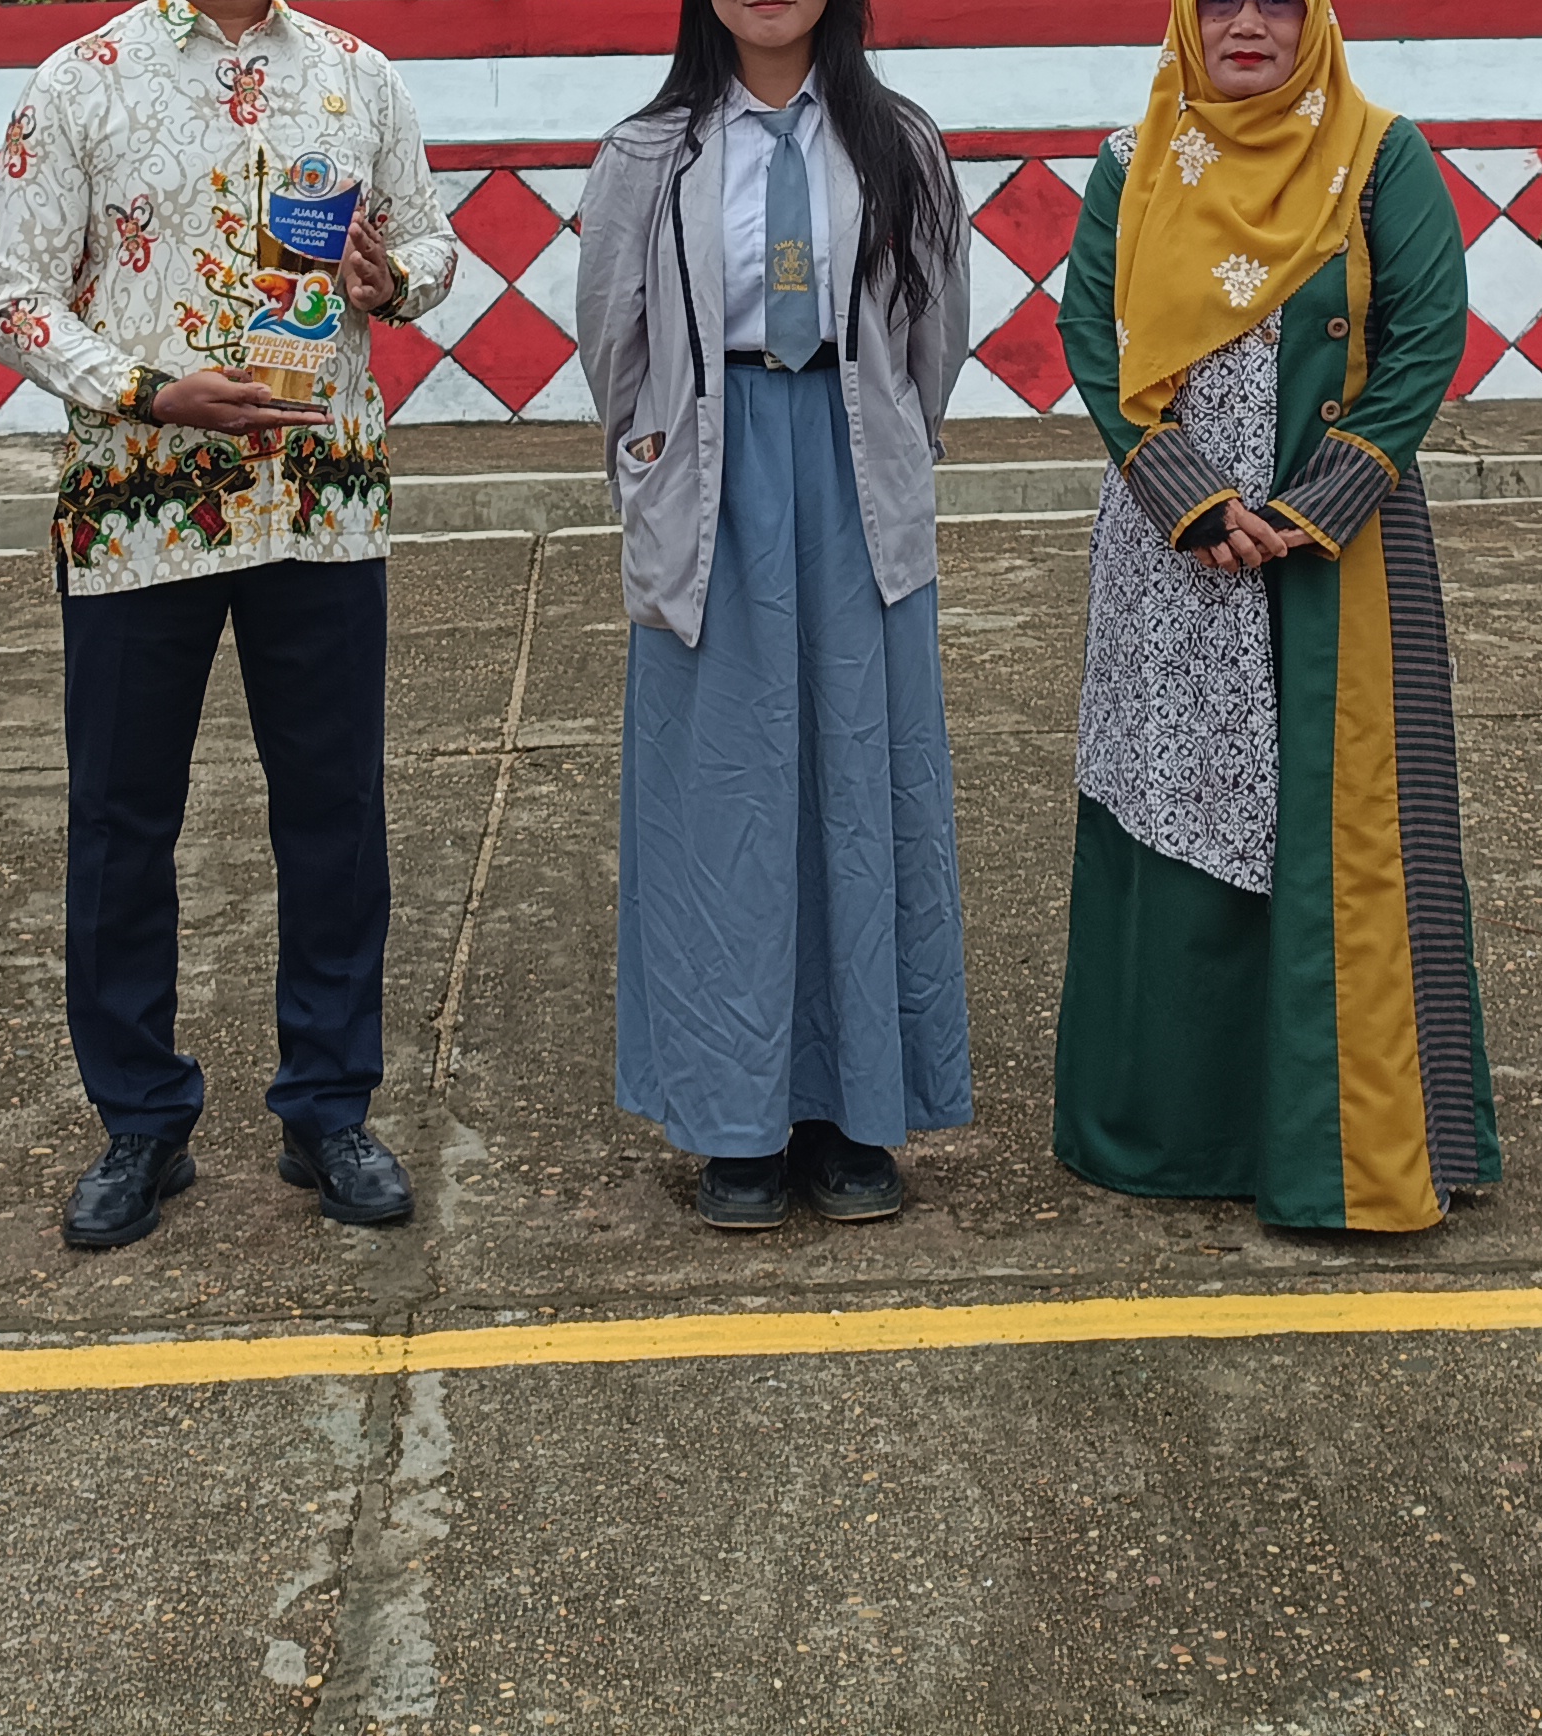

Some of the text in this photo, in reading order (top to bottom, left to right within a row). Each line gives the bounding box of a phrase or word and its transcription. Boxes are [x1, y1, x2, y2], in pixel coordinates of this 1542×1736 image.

[291, 207, 326, 219] JUARA
[275, 217, 347, 232] KARNAVAL BUDAYA
[291, 228, 329, 239] KATEGORI
[291, 236, 326, 247] PELAJAR
[245, 334, 335, 355] MURUNG RAYA
[250, 347, 325, 370] HEBAT
